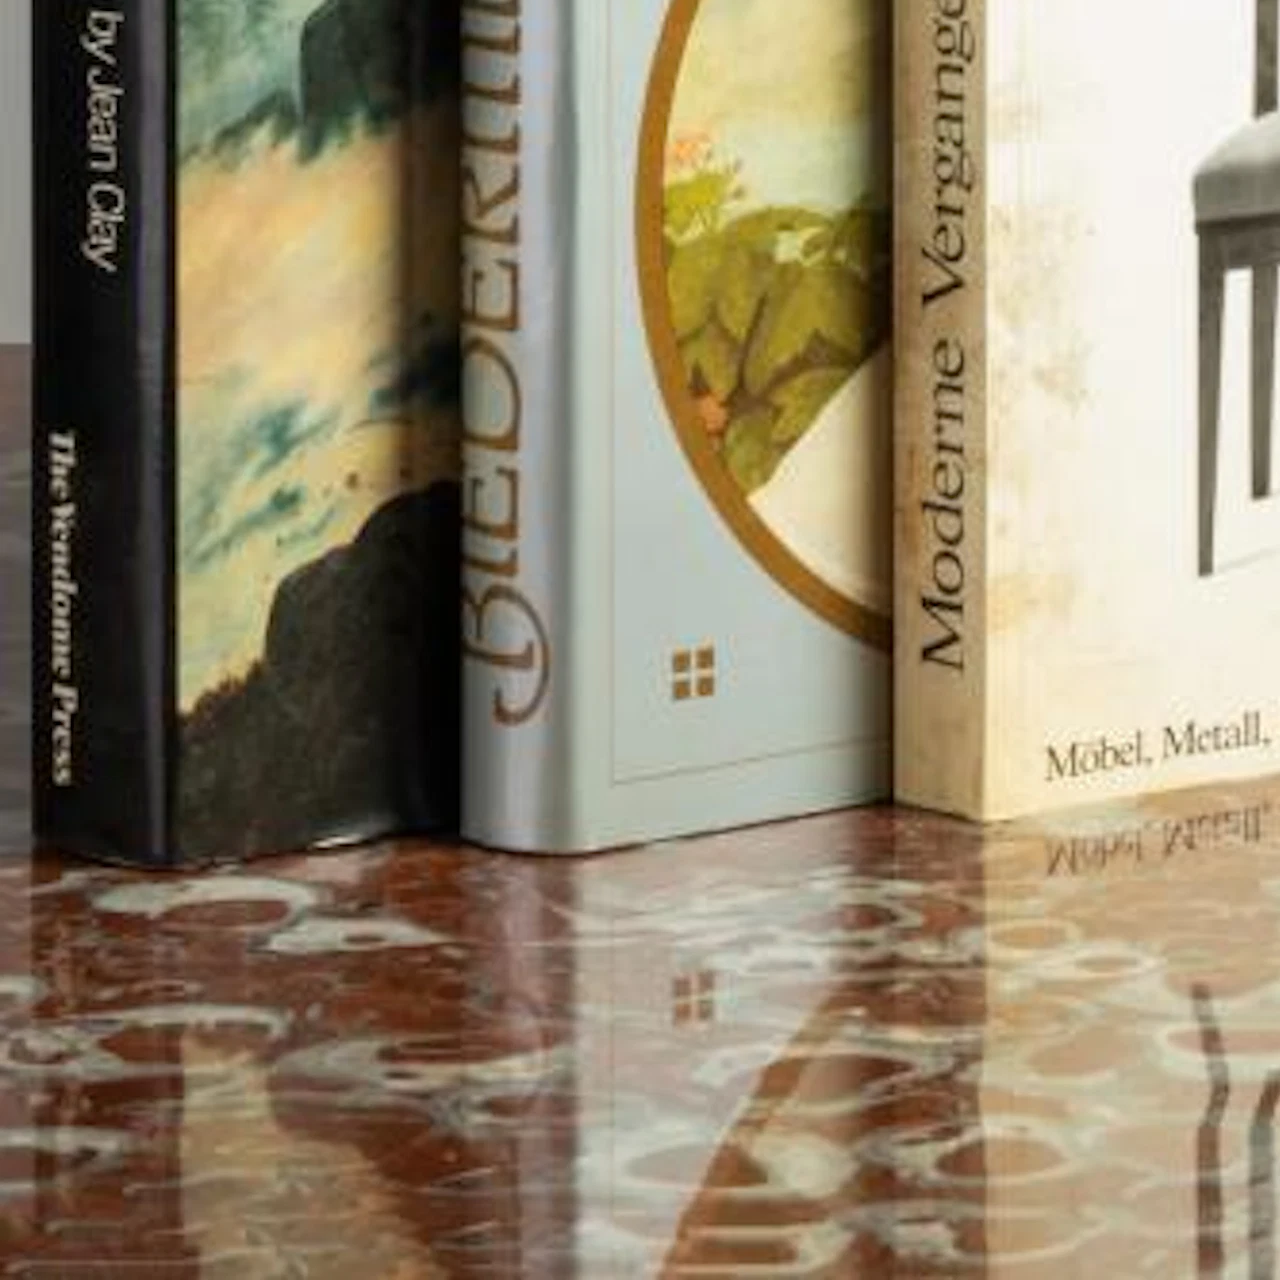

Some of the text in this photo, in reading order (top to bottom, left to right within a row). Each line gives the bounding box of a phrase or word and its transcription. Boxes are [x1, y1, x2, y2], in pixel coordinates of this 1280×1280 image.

[80, 8, 126, 273] by Jean Clay
[49, 432, 80, 787] The Vendome Press
[921, 338, 967, 672] Moderne
[1044, 728, 1154, 783] Möbel,
[1161, 710, 1273, 761] Metall,
